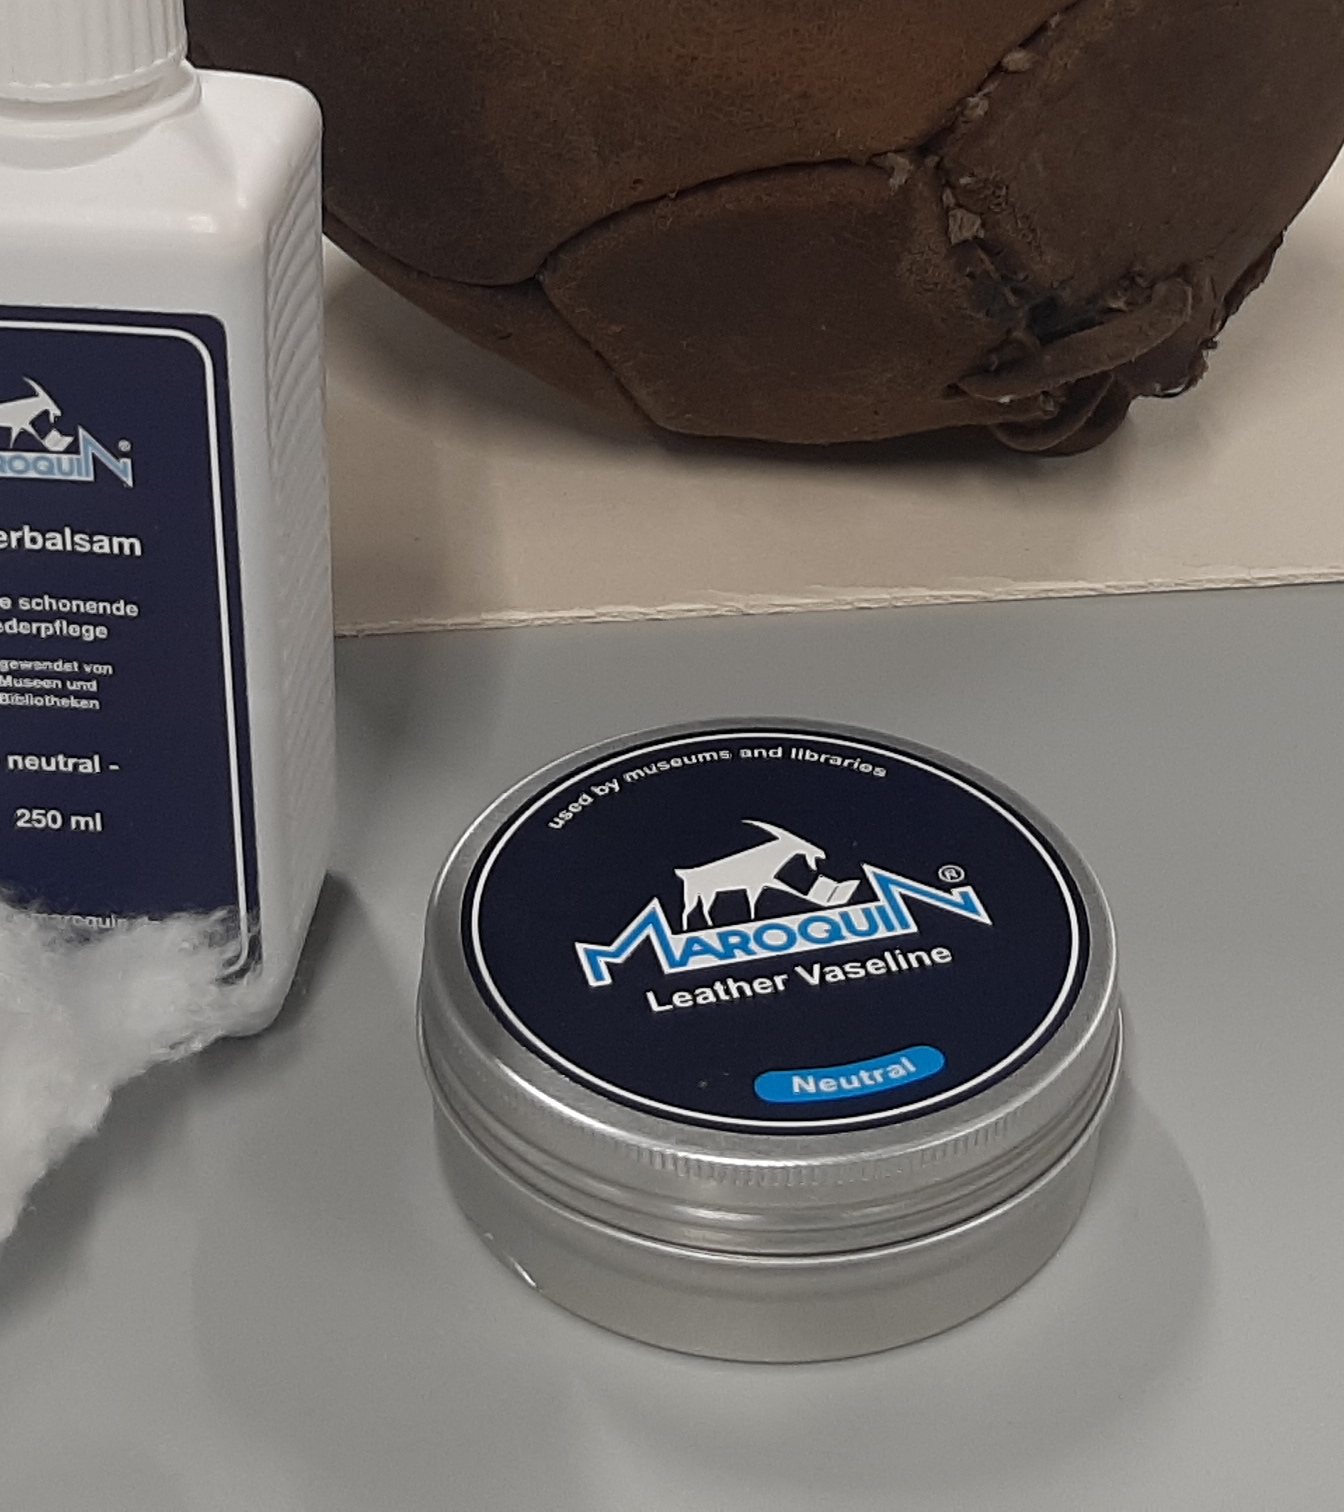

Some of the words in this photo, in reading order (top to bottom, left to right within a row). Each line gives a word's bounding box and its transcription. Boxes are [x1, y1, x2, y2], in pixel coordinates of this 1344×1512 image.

[18, 594, 140, 618] schonende
[83, 662, 114, 676] von
[66, 679, 98, 692] und
[7, 753, 101, 774] neutral
[547, 792, 594, 829] used
[590, 777, 621, 795] by
[623, 749, 732, 784] museums
[739, 746, 783, 759] and
[790, 746, 888, 778] libraries
[15, 808, 63, 829] 250
[70, 812, 102, 832] ml
[575, 863, 992, 988] MAROQUIN
[646, 971, 789, 1013] Leather
[794, 944, 953, 987] Vaseline
[792, 1057, 916, 1093] Neutral
